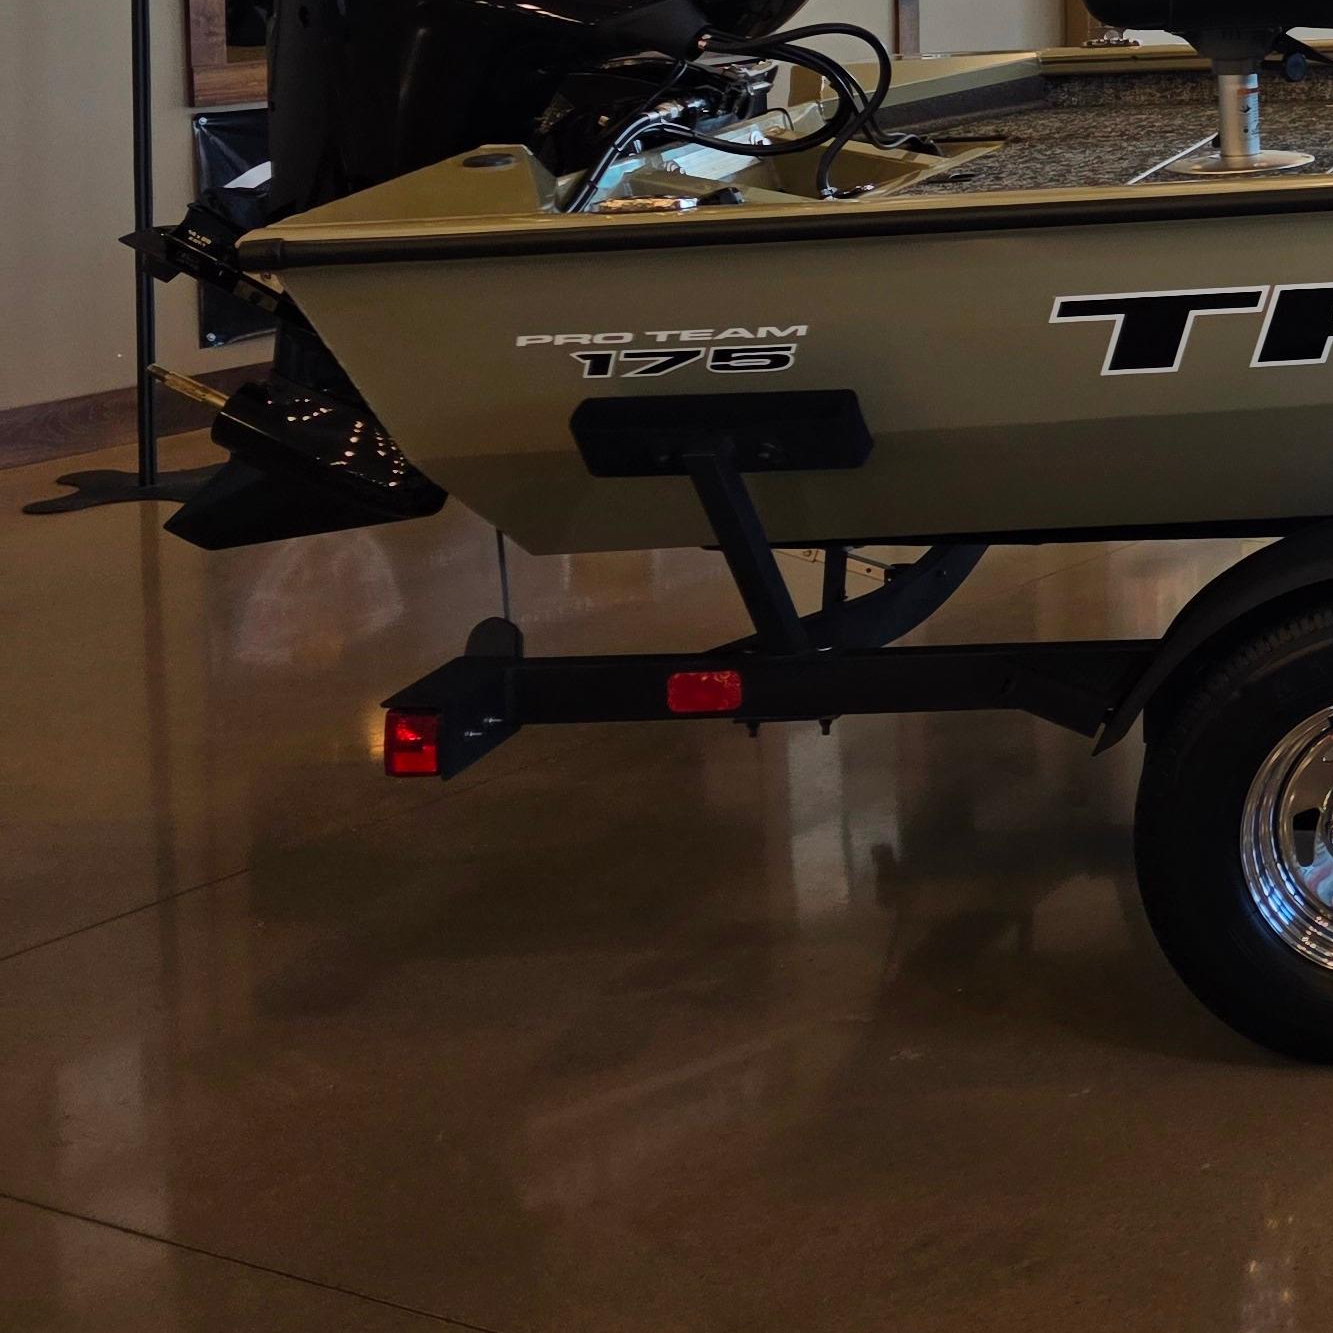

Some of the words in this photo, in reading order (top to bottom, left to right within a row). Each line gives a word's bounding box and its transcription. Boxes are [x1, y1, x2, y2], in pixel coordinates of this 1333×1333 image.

[516, 332, 633, 346] PRO
[645, 325, 808, 342] TEAM
[569, 343, 797, 378] 175
